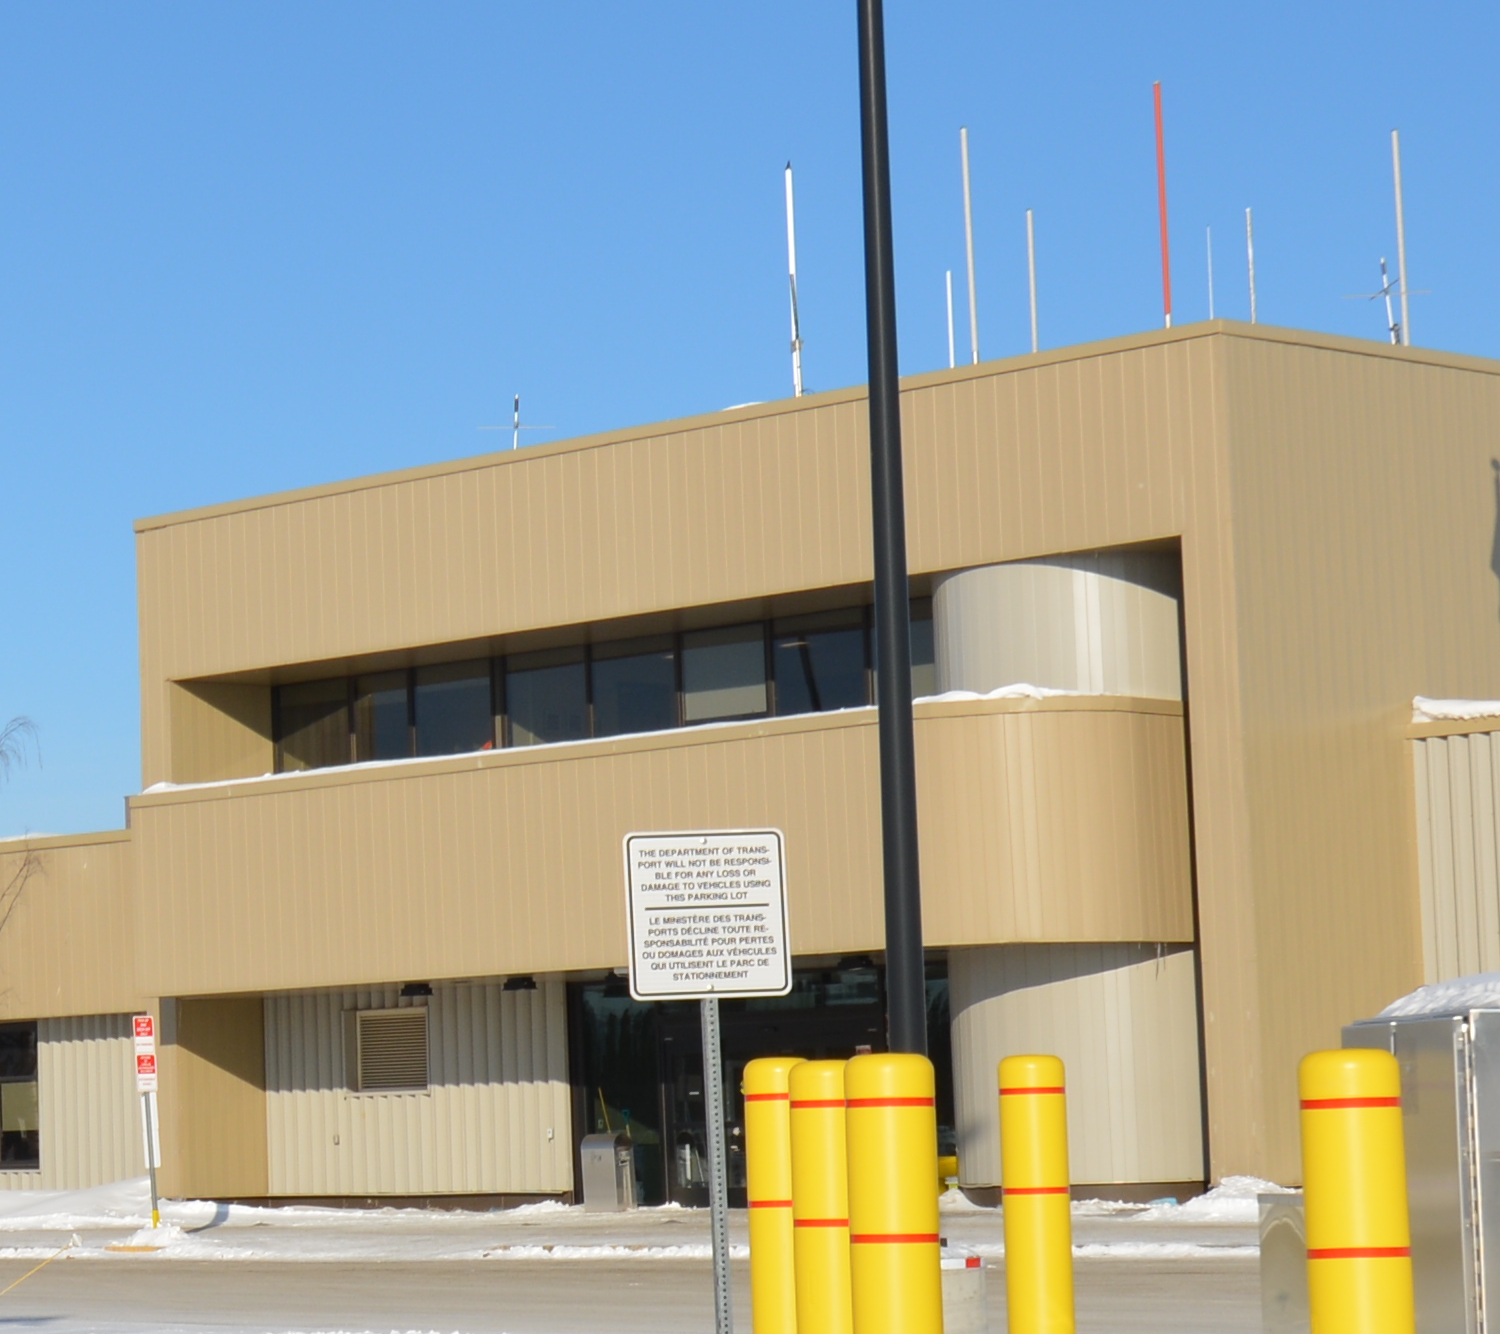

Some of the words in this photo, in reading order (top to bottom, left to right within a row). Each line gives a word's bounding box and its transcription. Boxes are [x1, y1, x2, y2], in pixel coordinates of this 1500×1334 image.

[639, 849, 656, 857] THE
[659, 848, 719, 857] DEPARTMENT
[722, 847, 734, 855] OF
[737, 846, 770, 854] TRANS-
[638, 860, 661, 869] PORT
[665, 860, 686, 868] WILL
[688, 859, 706, 867] NOT
[710, 858, 721, 866] BE
[724, 857, 772, 866] RESPONSI-
[655, 871, 672, 880] BLE
[675, 871, 693, 879] FOR
[696, 870, 714, 878] ANY
[717, 869, 741, 877] LOSS
[743, 869, 756, 877] OR
[641, 882, 680, 891] DAMAGE
[682, 882, 695, 890] TO
[697, 880, 741, 889] VEHICLES
[743, 879, 771, 888] USING
[665, 893, 686, 902] THIS
[688, 892, 728, 901] PARKING
[731, 891, 748, 899] LOT
[649, 917, 660, 925] LE
[663, 914, 710, 925] MINISTÈRE
[713, 914, 731, 923] DES
[733, 913, 766, 922] TRANS-
[648, 928, 679, 936] PORTS
[681, 925, 719, 935] DÉCLINE
[722, 925, 751, 934] TOUTE
[644, 937, 709, 948] SPONSABILITÉ
[711, 937, 736, 946] POUR
[739, 936, 774, 945] PERTES
[642, 951, 655, 959] OU
[658, 949, 704, 958] DOMAGES
[706, 949, 724, 957] AUX
[726, 946, 777, 956] VÉHICULES
[651, 962, 667, 970] QUI
[669, 960, 714, 970] UTILISENT
[716, 959, 728, 968] LE
[730, 958, 755, 967] PARC
[757, 958, 769, 967] DE
[673, 970, 748, 981] STATIONNEMENT
